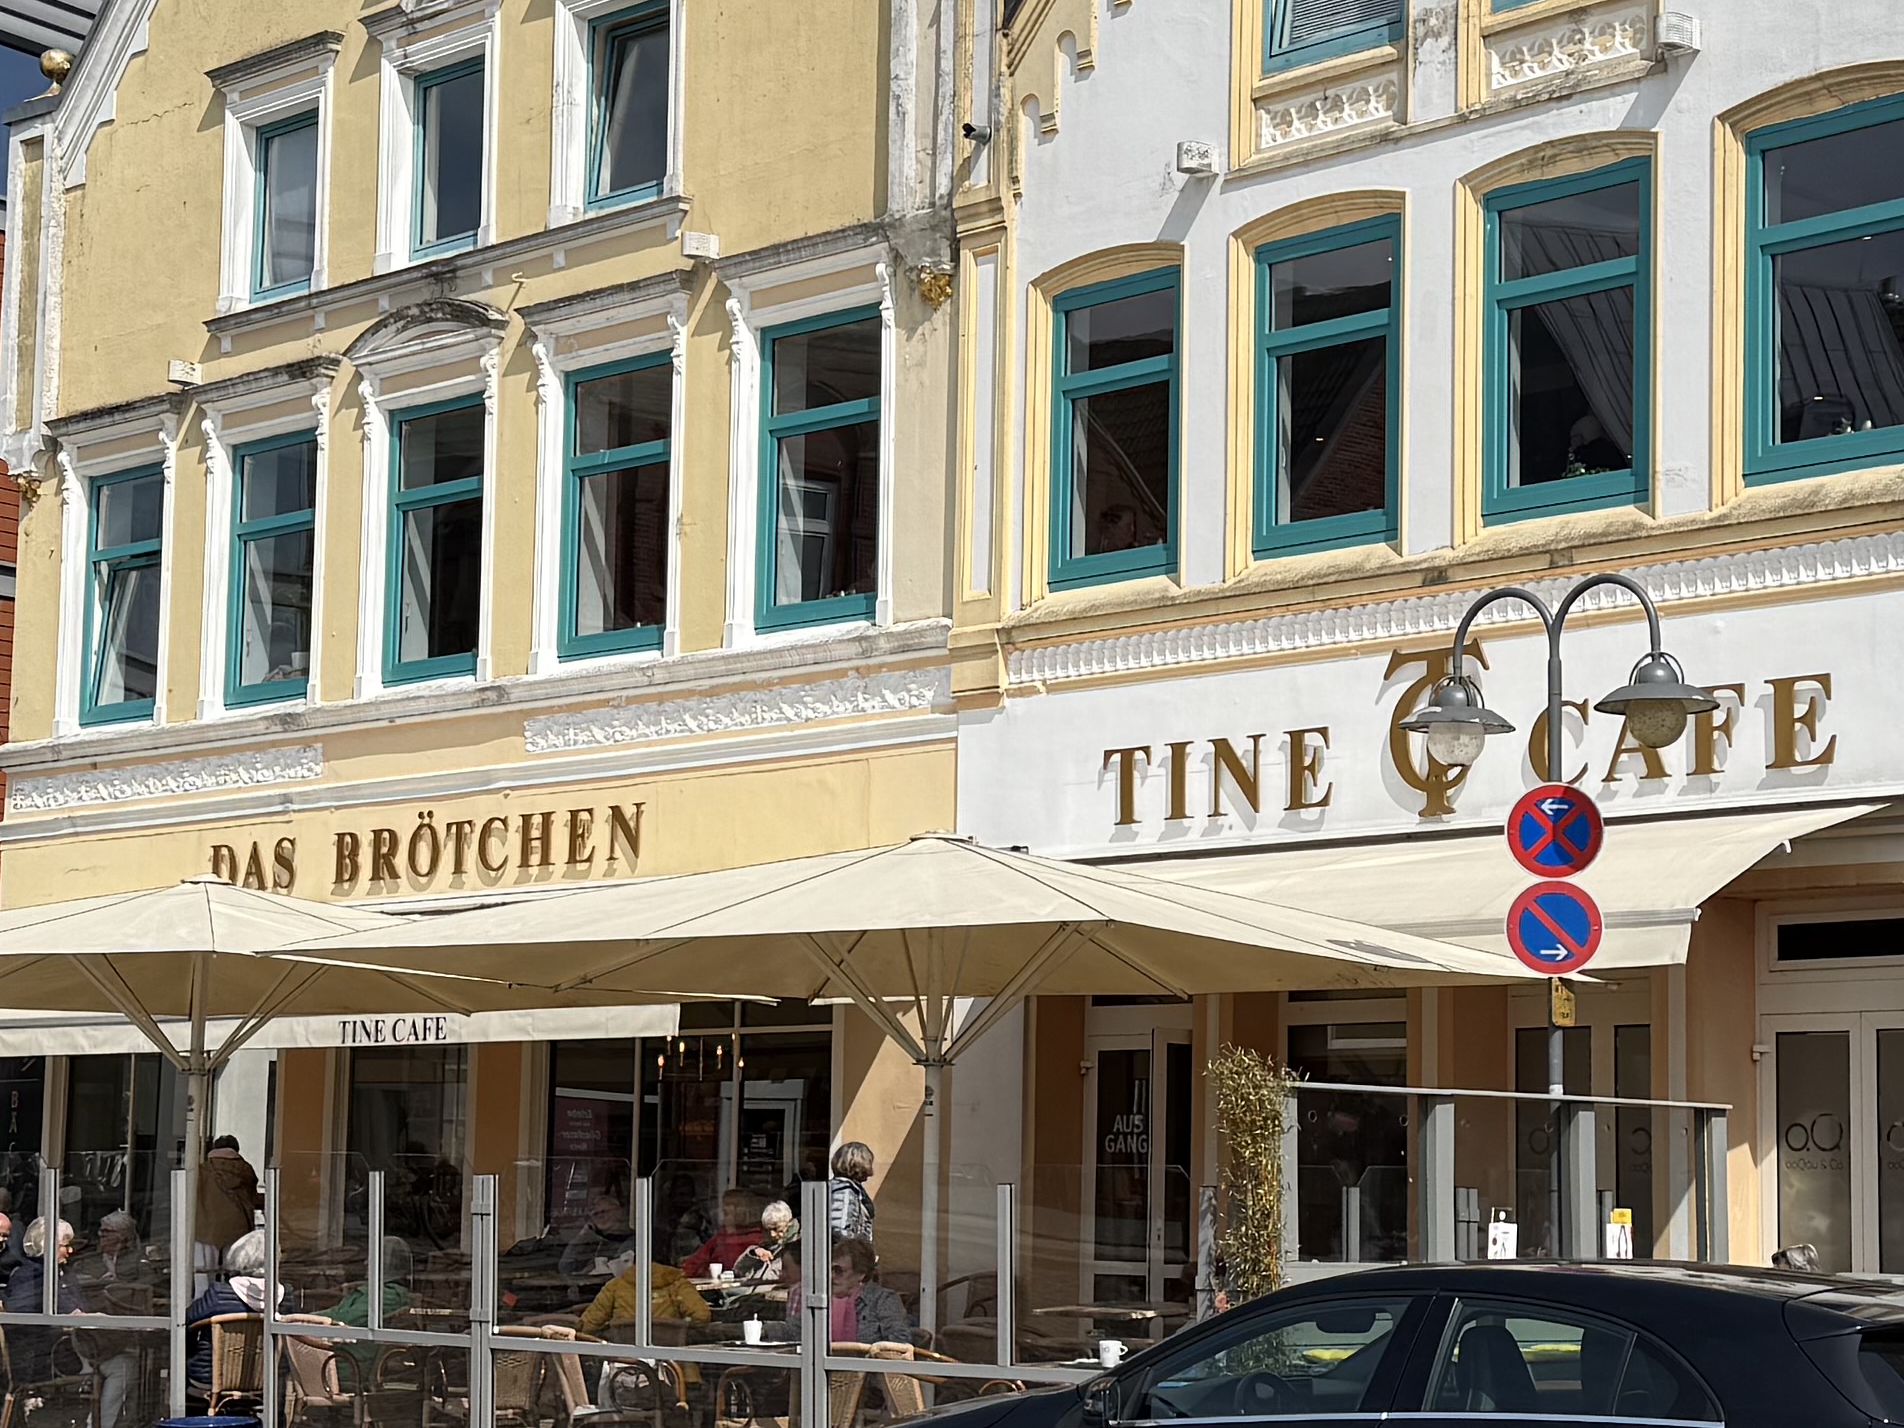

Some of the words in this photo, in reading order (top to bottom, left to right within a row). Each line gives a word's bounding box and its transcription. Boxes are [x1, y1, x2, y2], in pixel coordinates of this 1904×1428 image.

[1102, 725, 1333, 826] TINE
[210, 837, 296, 891] DAS
[333, 802, 646, 885] BRÖTCHEN
[338, 1019, 386, 1045] TINE
[392, 1016, 447, 1043] CAFE
[1113, 1114, 1144, 1132] AUS
[1104, 1134, 1148, 1153] GANG
